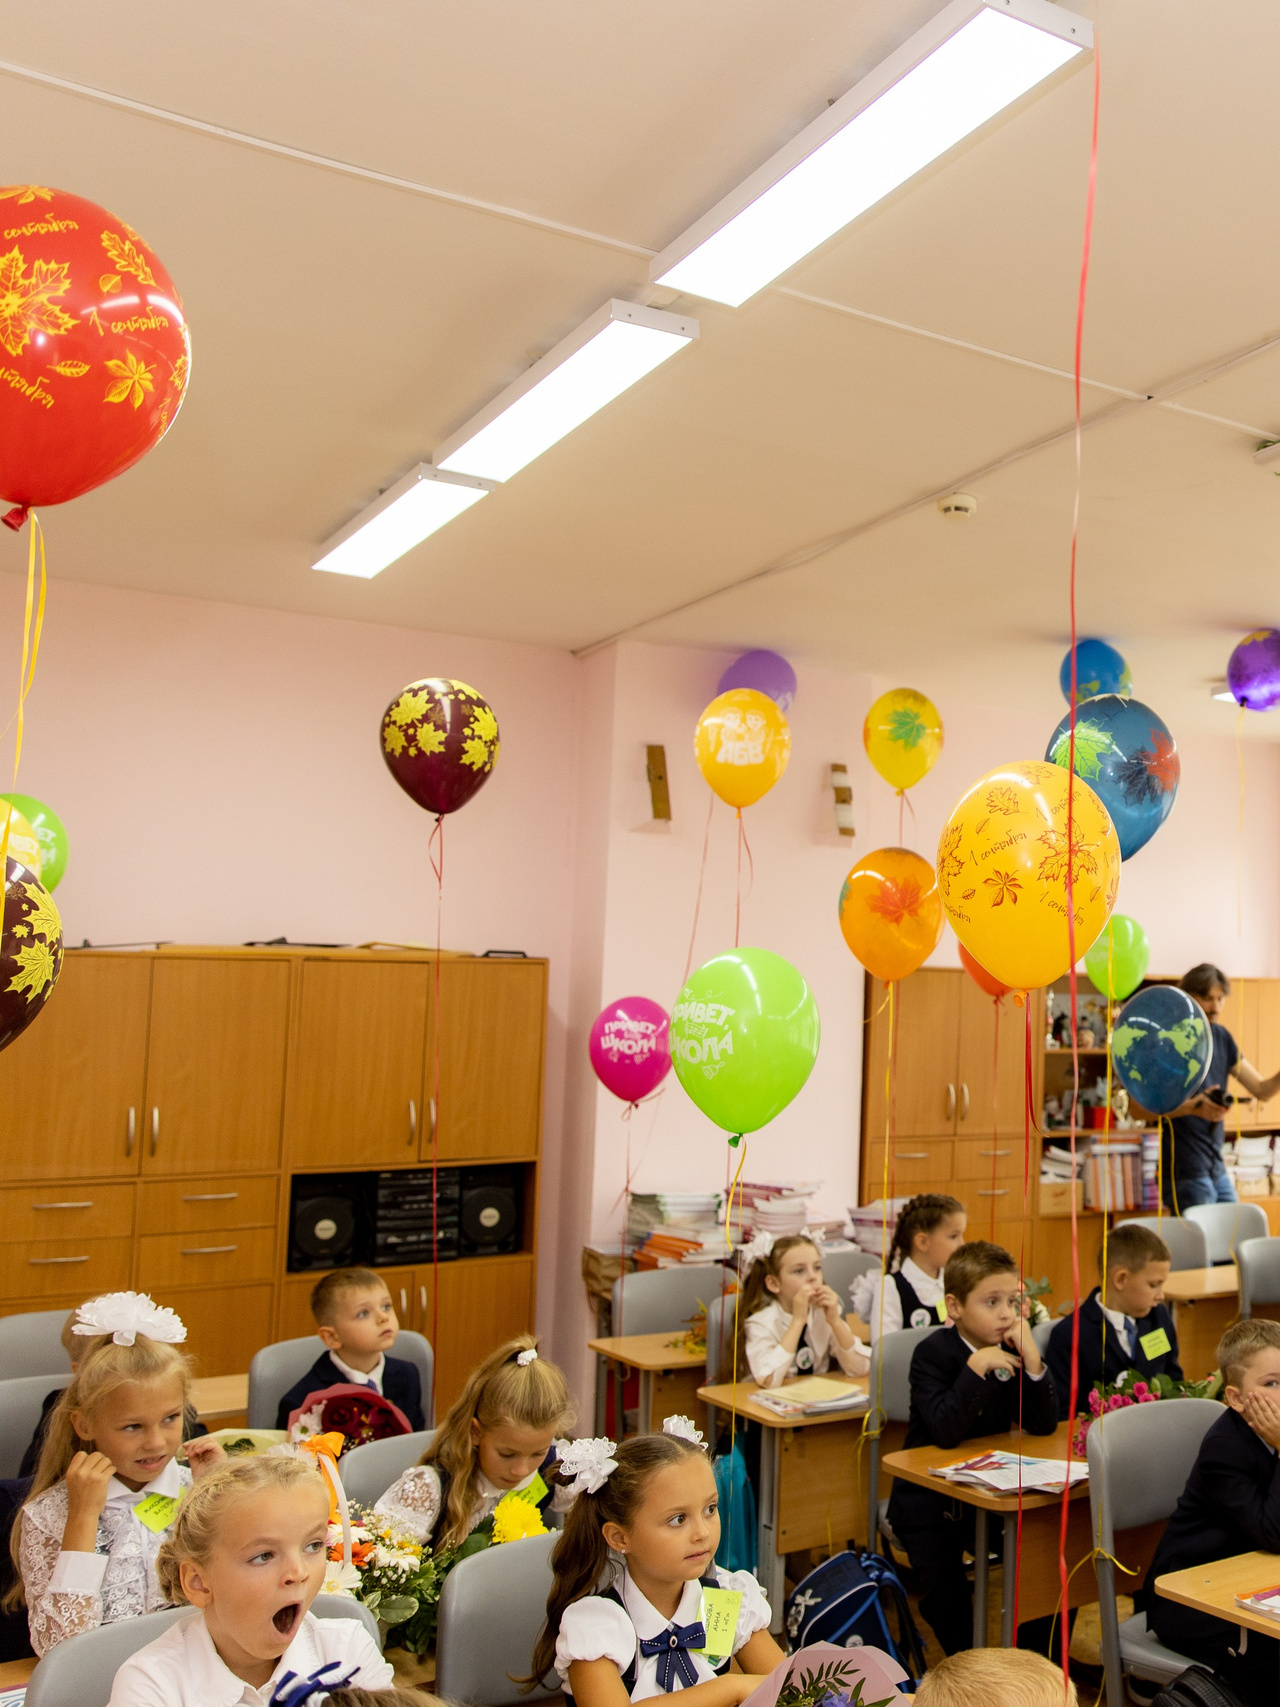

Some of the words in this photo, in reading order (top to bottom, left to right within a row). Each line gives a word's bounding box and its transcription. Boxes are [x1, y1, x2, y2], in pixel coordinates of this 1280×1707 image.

[4, 212, 79, 240] сентября
[89, 308, 104, 337] 1
[111, 305, 169, 334] сентября
[716, 742, 765, 767] АБВ
[1051, 787, 1081, 815] сентря
[969, 849, 979, 866] 1
[980, 828, 1027, 861] сентября
[1039, 890, 1050, 903] 1
[1047, 899, 1085, 927] сентбря
[600, 1032, 657, 1055] ШКОЛА
[713, 1612, 721, 1631] АННА
